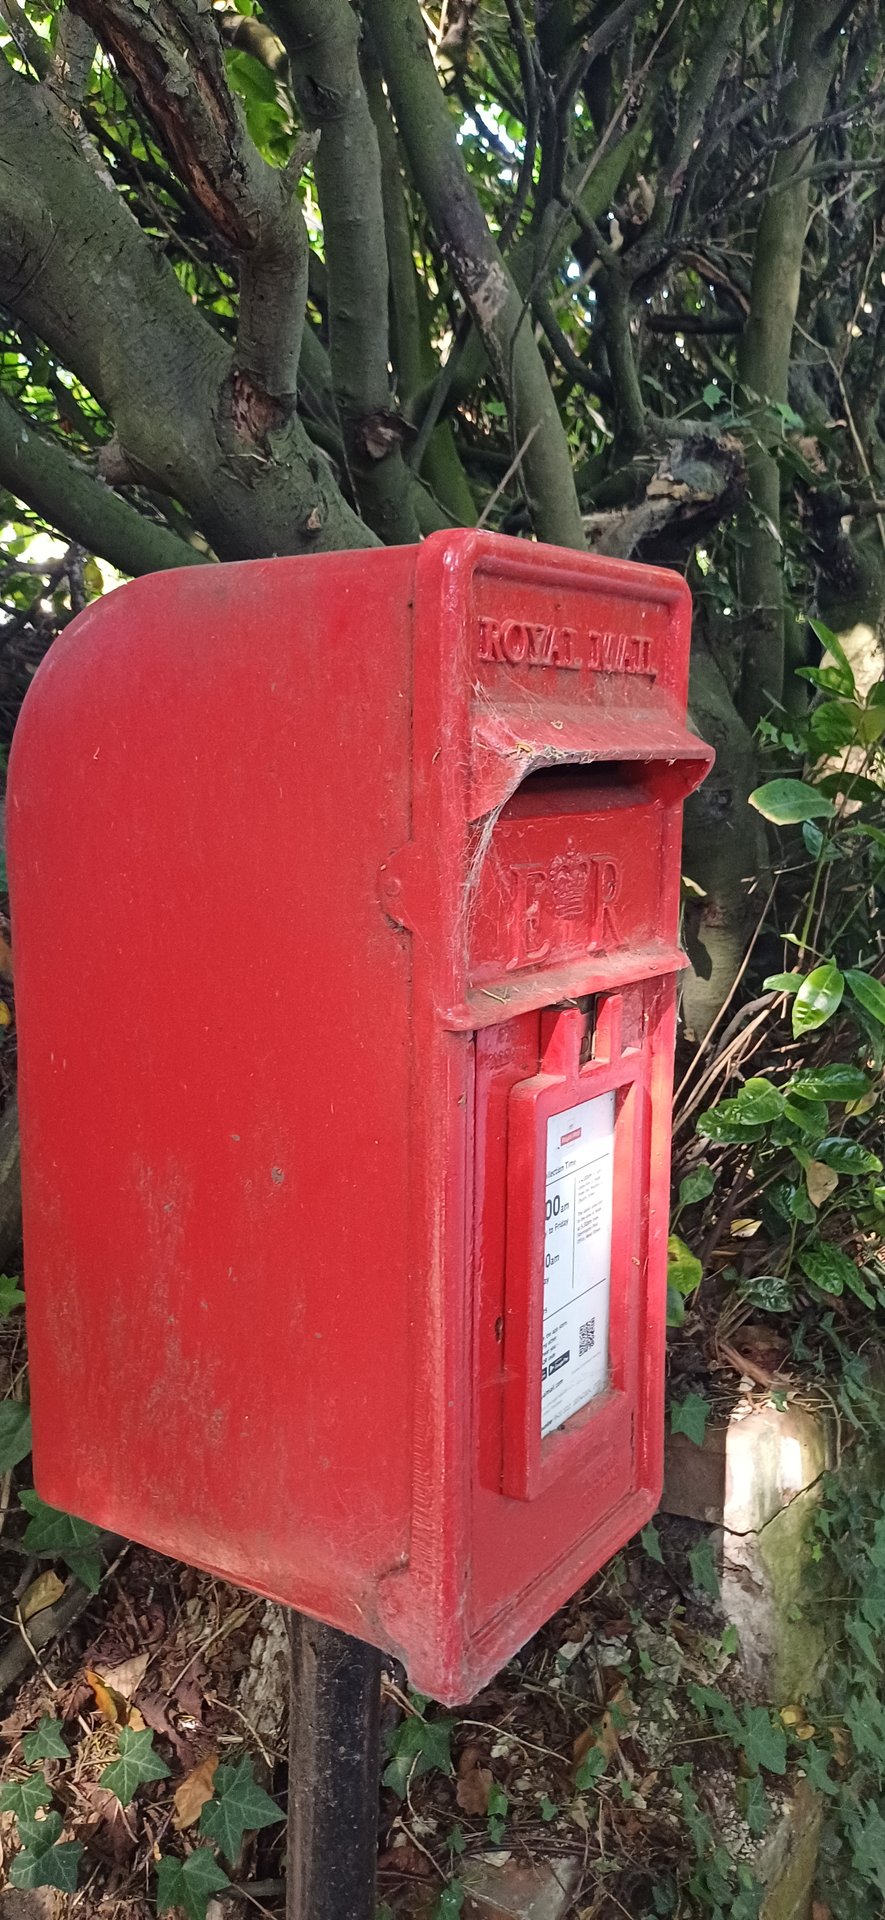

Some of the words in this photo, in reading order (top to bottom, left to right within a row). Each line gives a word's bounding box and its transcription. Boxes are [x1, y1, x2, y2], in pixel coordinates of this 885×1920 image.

[477, 615, 583, 671] ROYAL
[588, 629, 659, 676] MAIL
[505, 862, 550, 972] E
[586, 853, 630, 957] R
[554, 1219, 569, 1231] Friday
